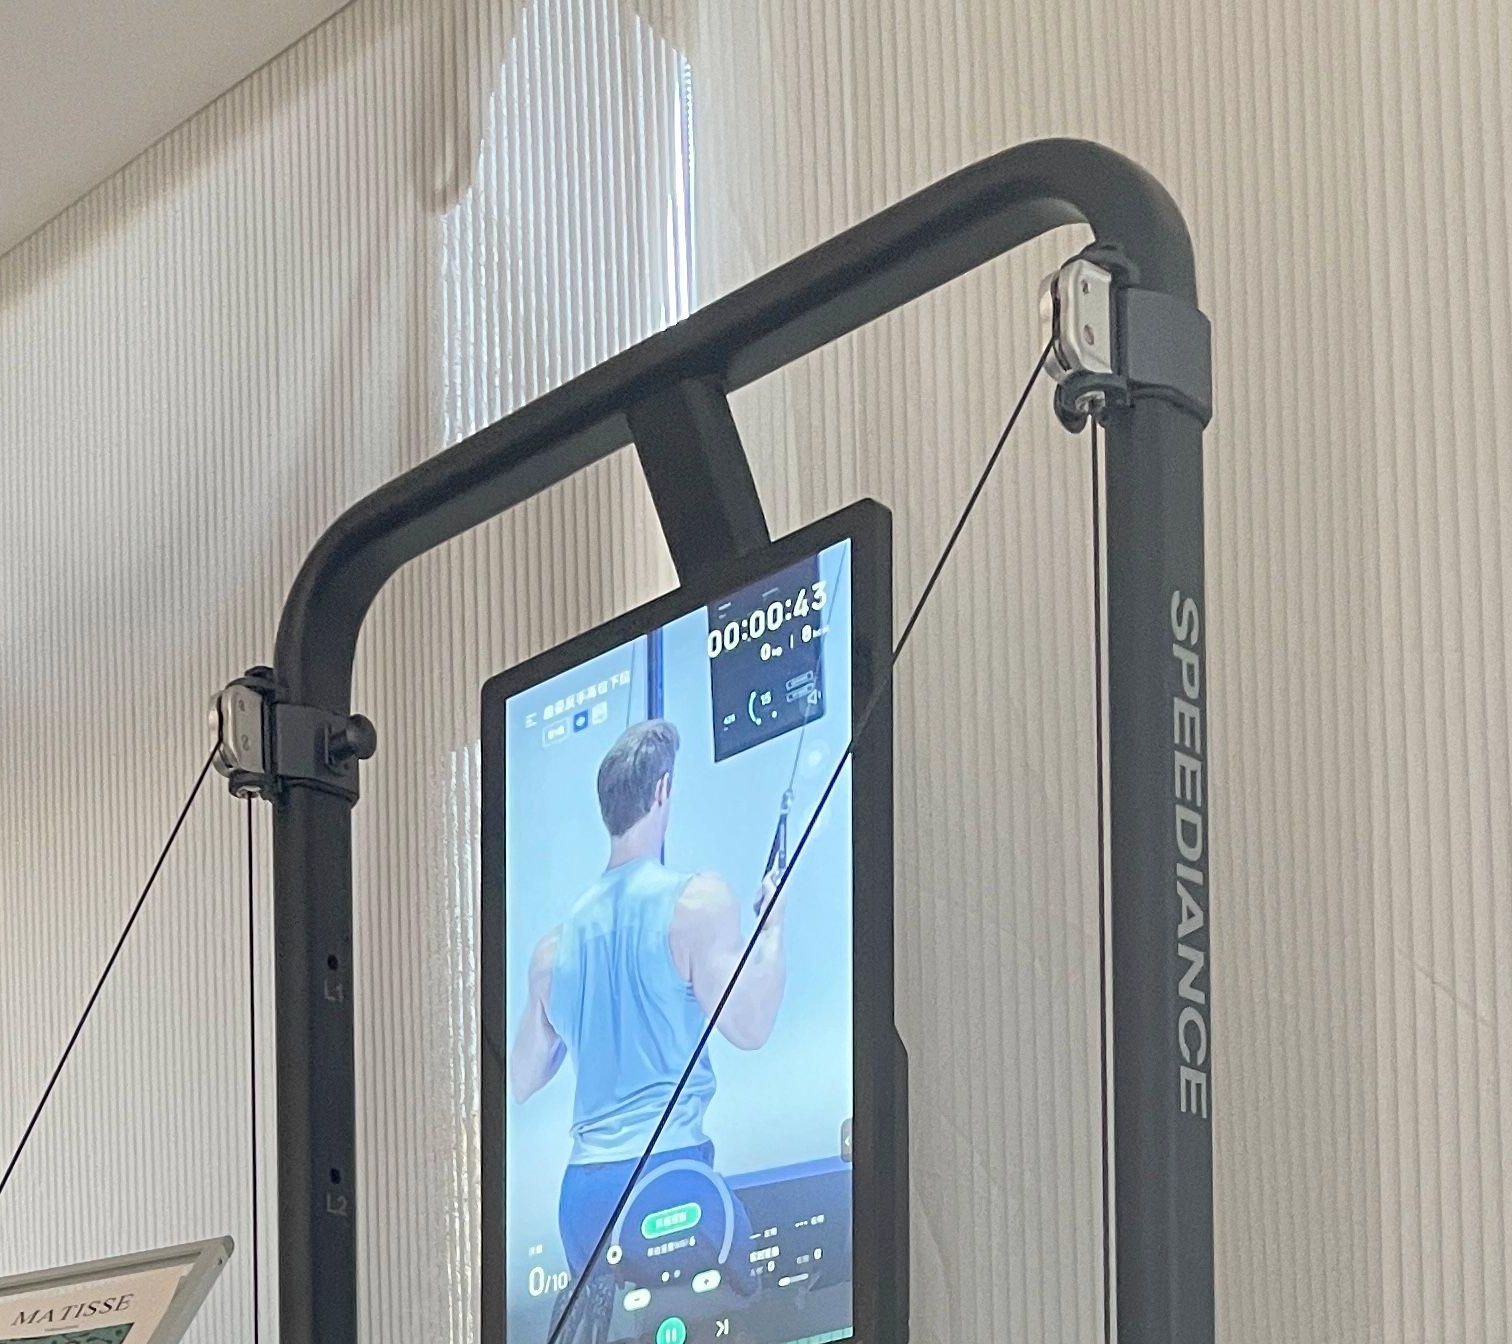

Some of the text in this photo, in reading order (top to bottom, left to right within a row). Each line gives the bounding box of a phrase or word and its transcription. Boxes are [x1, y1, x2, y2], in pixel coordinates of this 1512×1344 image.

[708, 580, 827, 658] 00:00:43
[1170, 590, 1208, 1119] SPEEDIANCE
[327, 1192, 348, 1217] L2
[528, 1266, 569, 1297] 0/10
[10, 1293, 136, 1327] MATISSE
